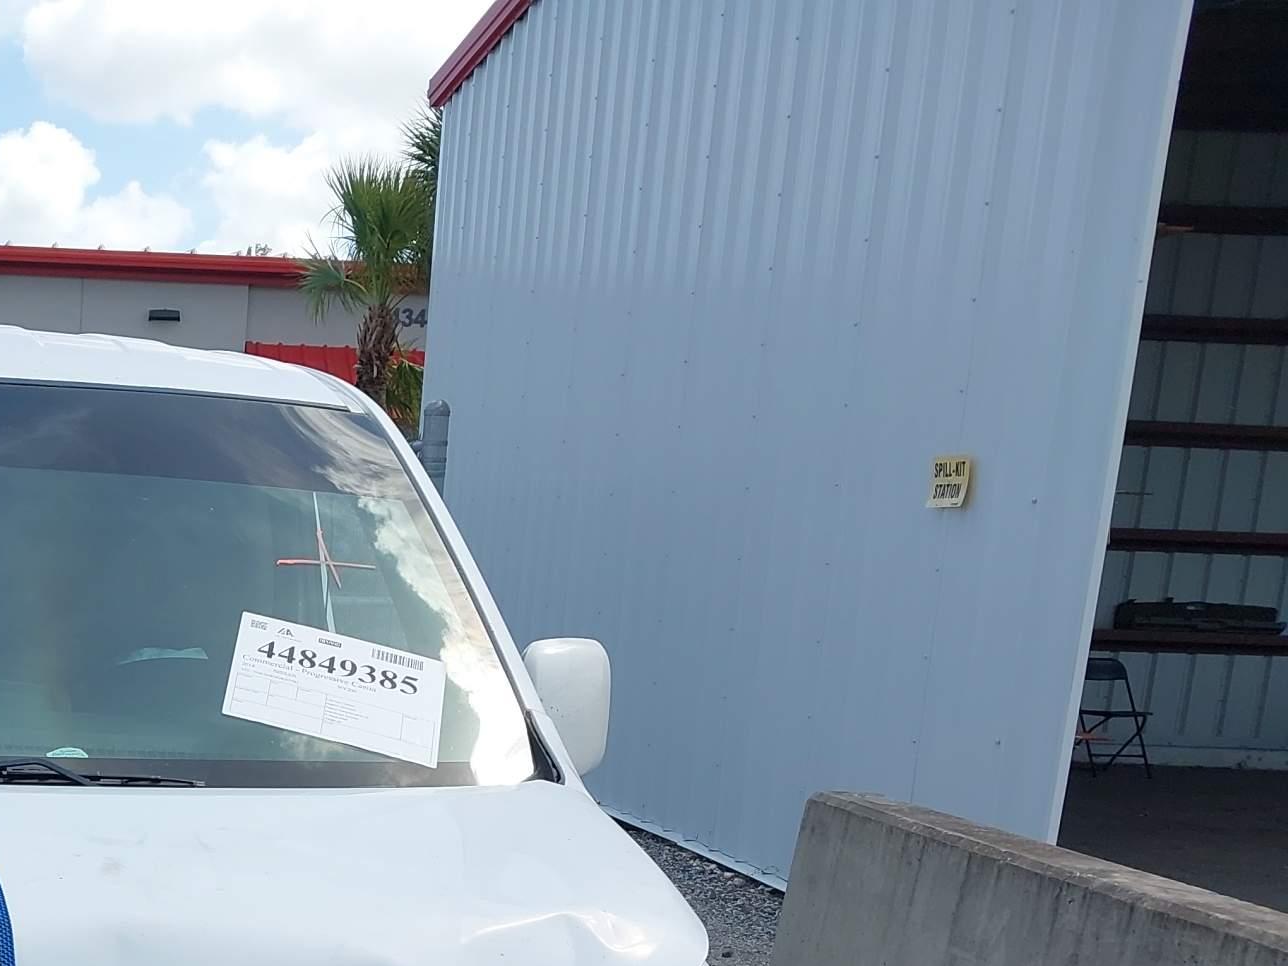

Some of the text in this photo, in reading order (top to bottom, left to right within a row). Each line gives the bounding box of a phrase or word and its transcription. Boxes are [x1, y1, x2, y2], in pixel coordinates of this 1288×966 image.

[932, 482, 962, 500] STATION
[242, 654, 293, 671] Commercial
[257, 640, 419, 695] 44849385
